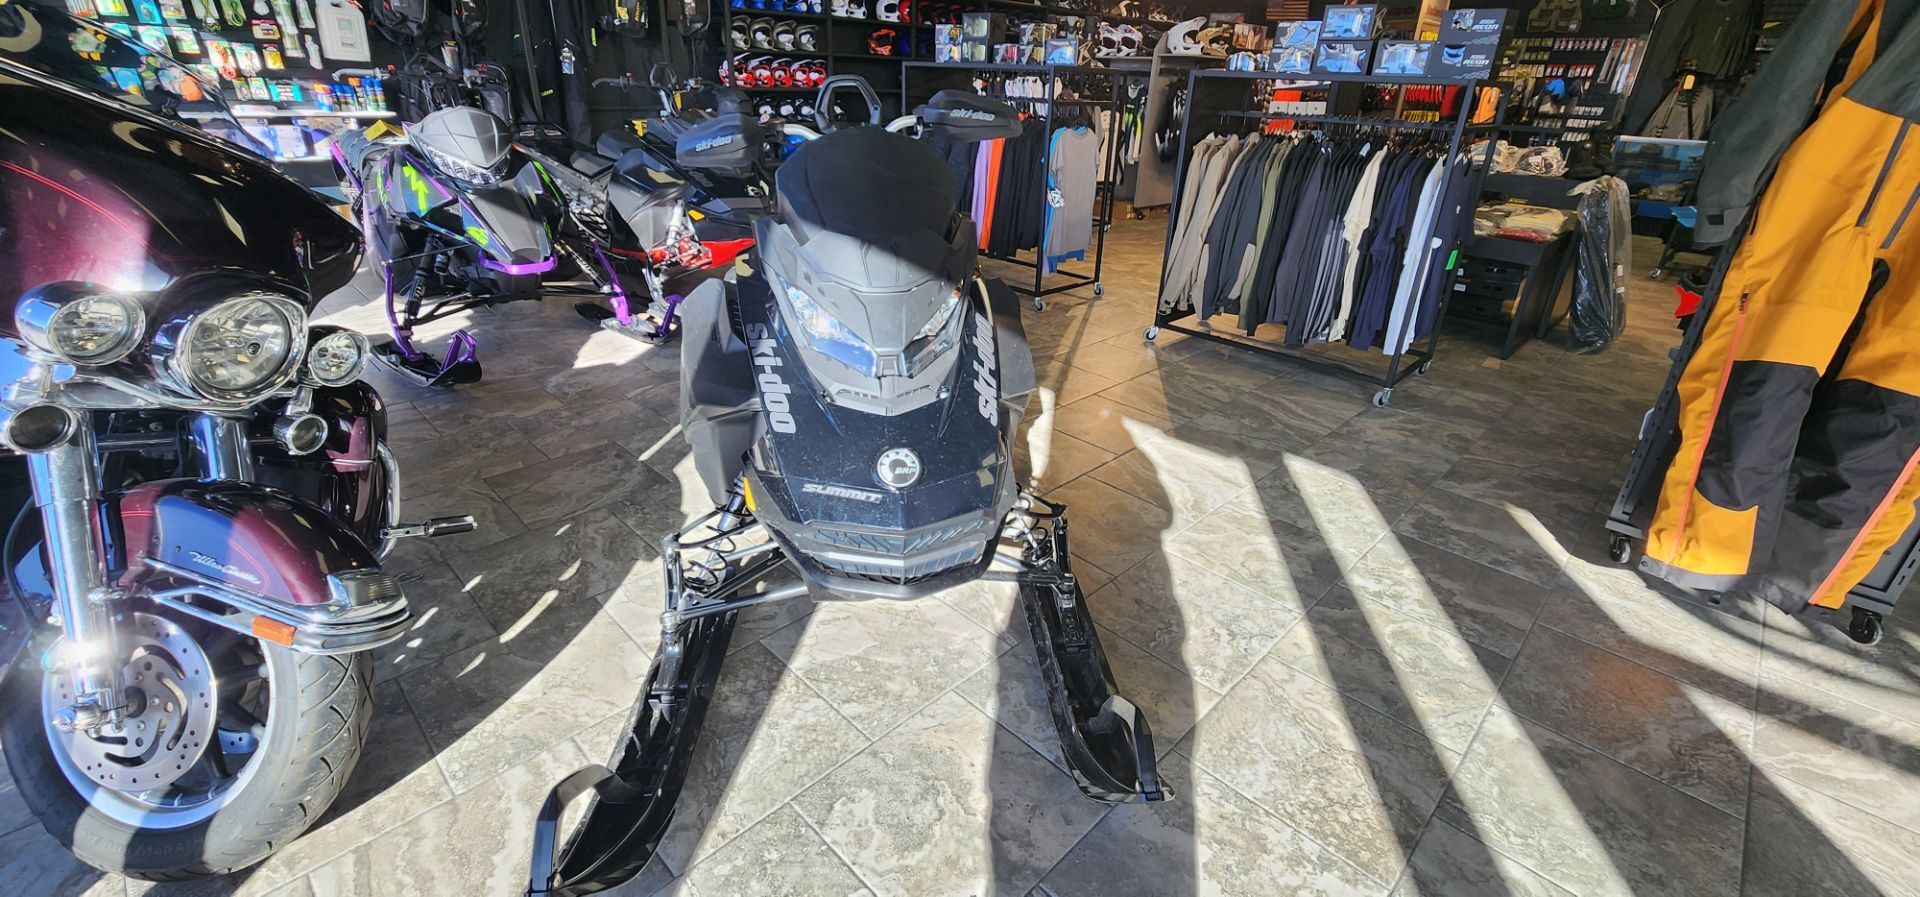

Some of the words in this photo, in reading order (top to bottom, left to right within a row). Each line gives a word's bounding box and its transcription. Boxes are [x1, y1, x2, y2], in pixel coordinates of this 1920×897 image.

[950, 108, 996, 121] ski-doo
[695, 135, 732, 152] ski-doo
[745, 323, 797, 434] ski-doo
[973, 312, 998, 427] ski-doo
[894, 466, 917, 475] BRP
[801, 483, 883, 504] SUMMIT
